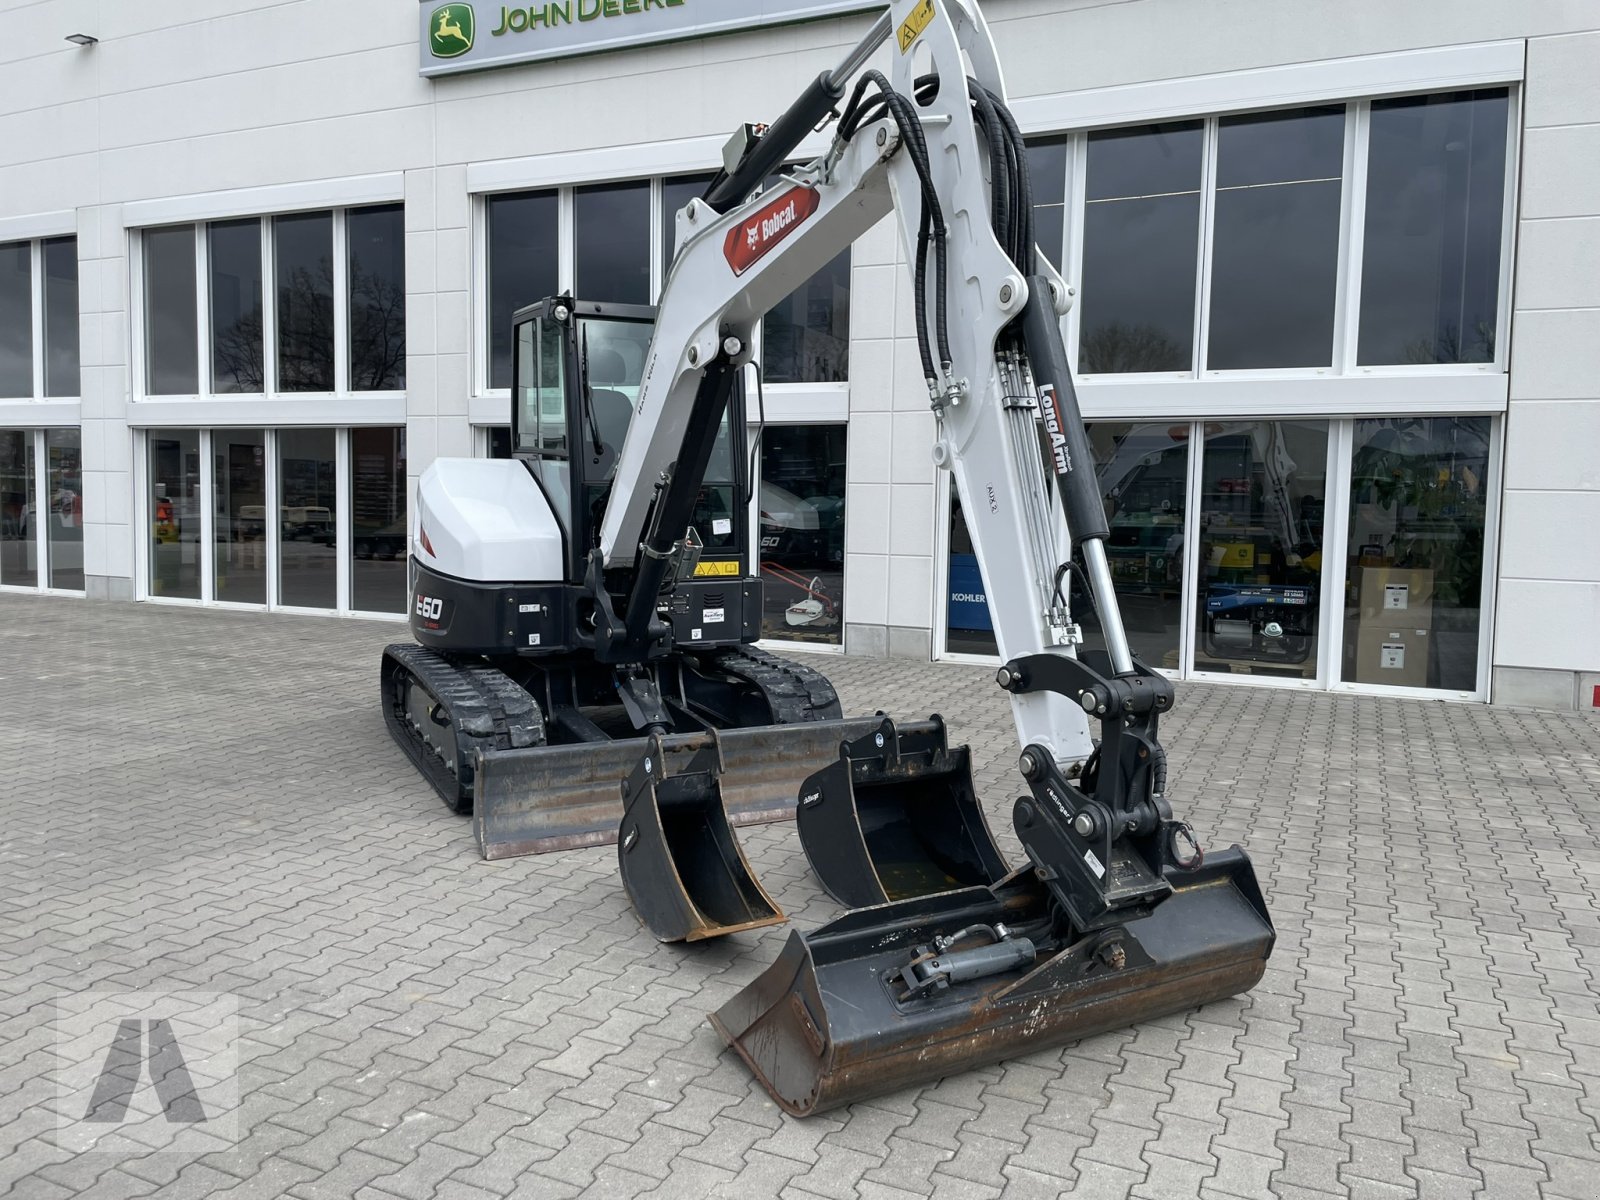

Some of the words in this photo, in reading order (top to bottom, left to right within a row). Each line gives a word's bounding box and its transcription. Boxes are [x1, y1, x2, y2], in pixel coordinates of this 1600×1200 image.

[491, 0, 573, 36] JOHN
[578, 0, 685, 22] DEE
[762, 199, 796, 241] Bobcat
[1039, 384, 1068, 474] LongArm
[987, 486, 997, 504] AUX
[951, 592, 986, 603] KOHLER
